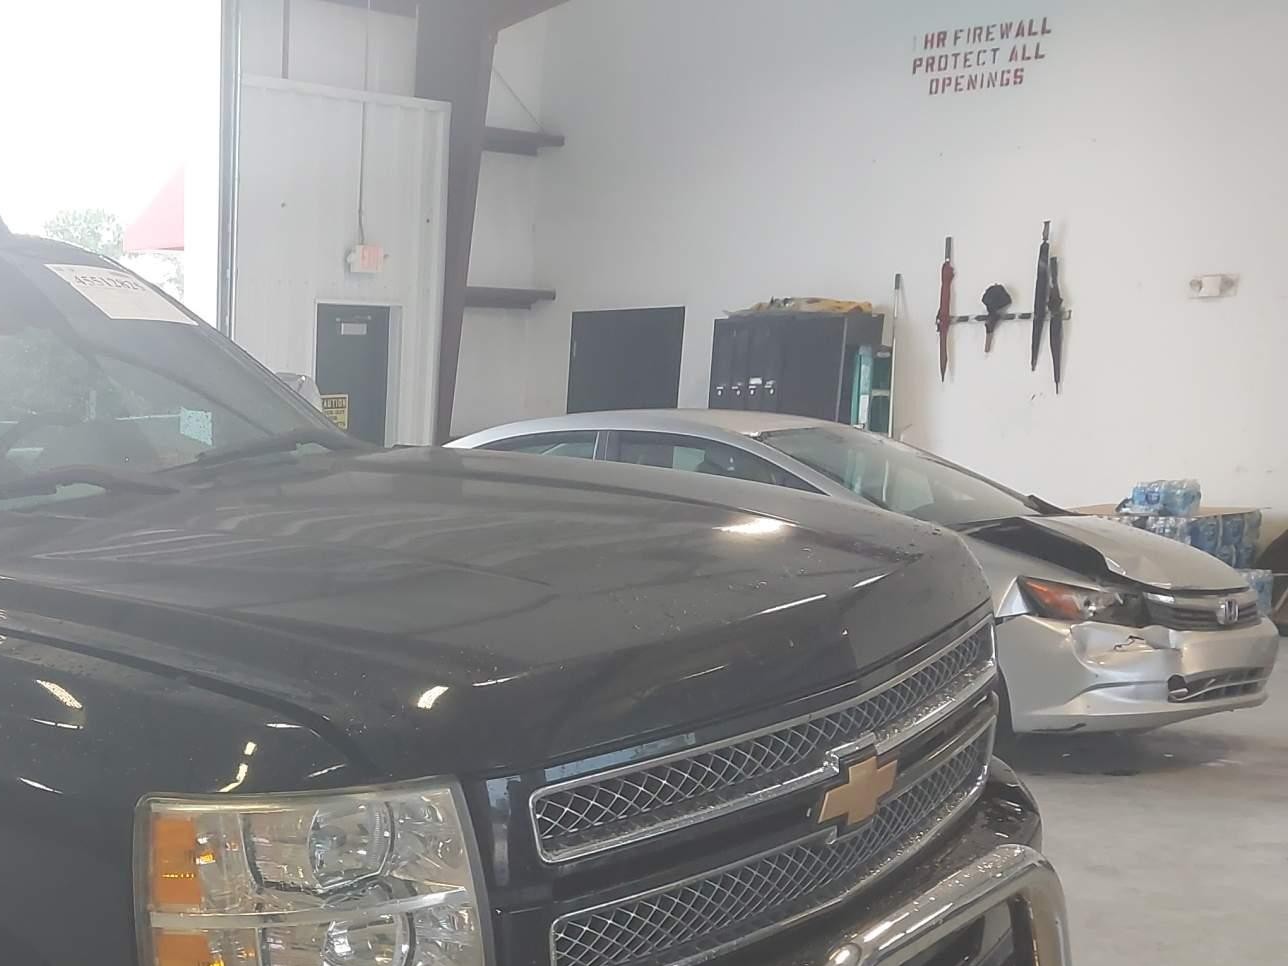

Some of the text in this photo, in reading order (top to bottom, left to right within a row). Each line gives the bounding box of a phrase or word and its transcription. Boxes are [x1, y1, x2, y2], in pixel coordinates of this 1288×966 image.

[923, 30, 947, 50] HR
[953, 17, 1052, 46] FIREWALL
[912, 42, 1046, 74] PROTECT ALL
[929, 67, 1025, 96] OPENINGS
